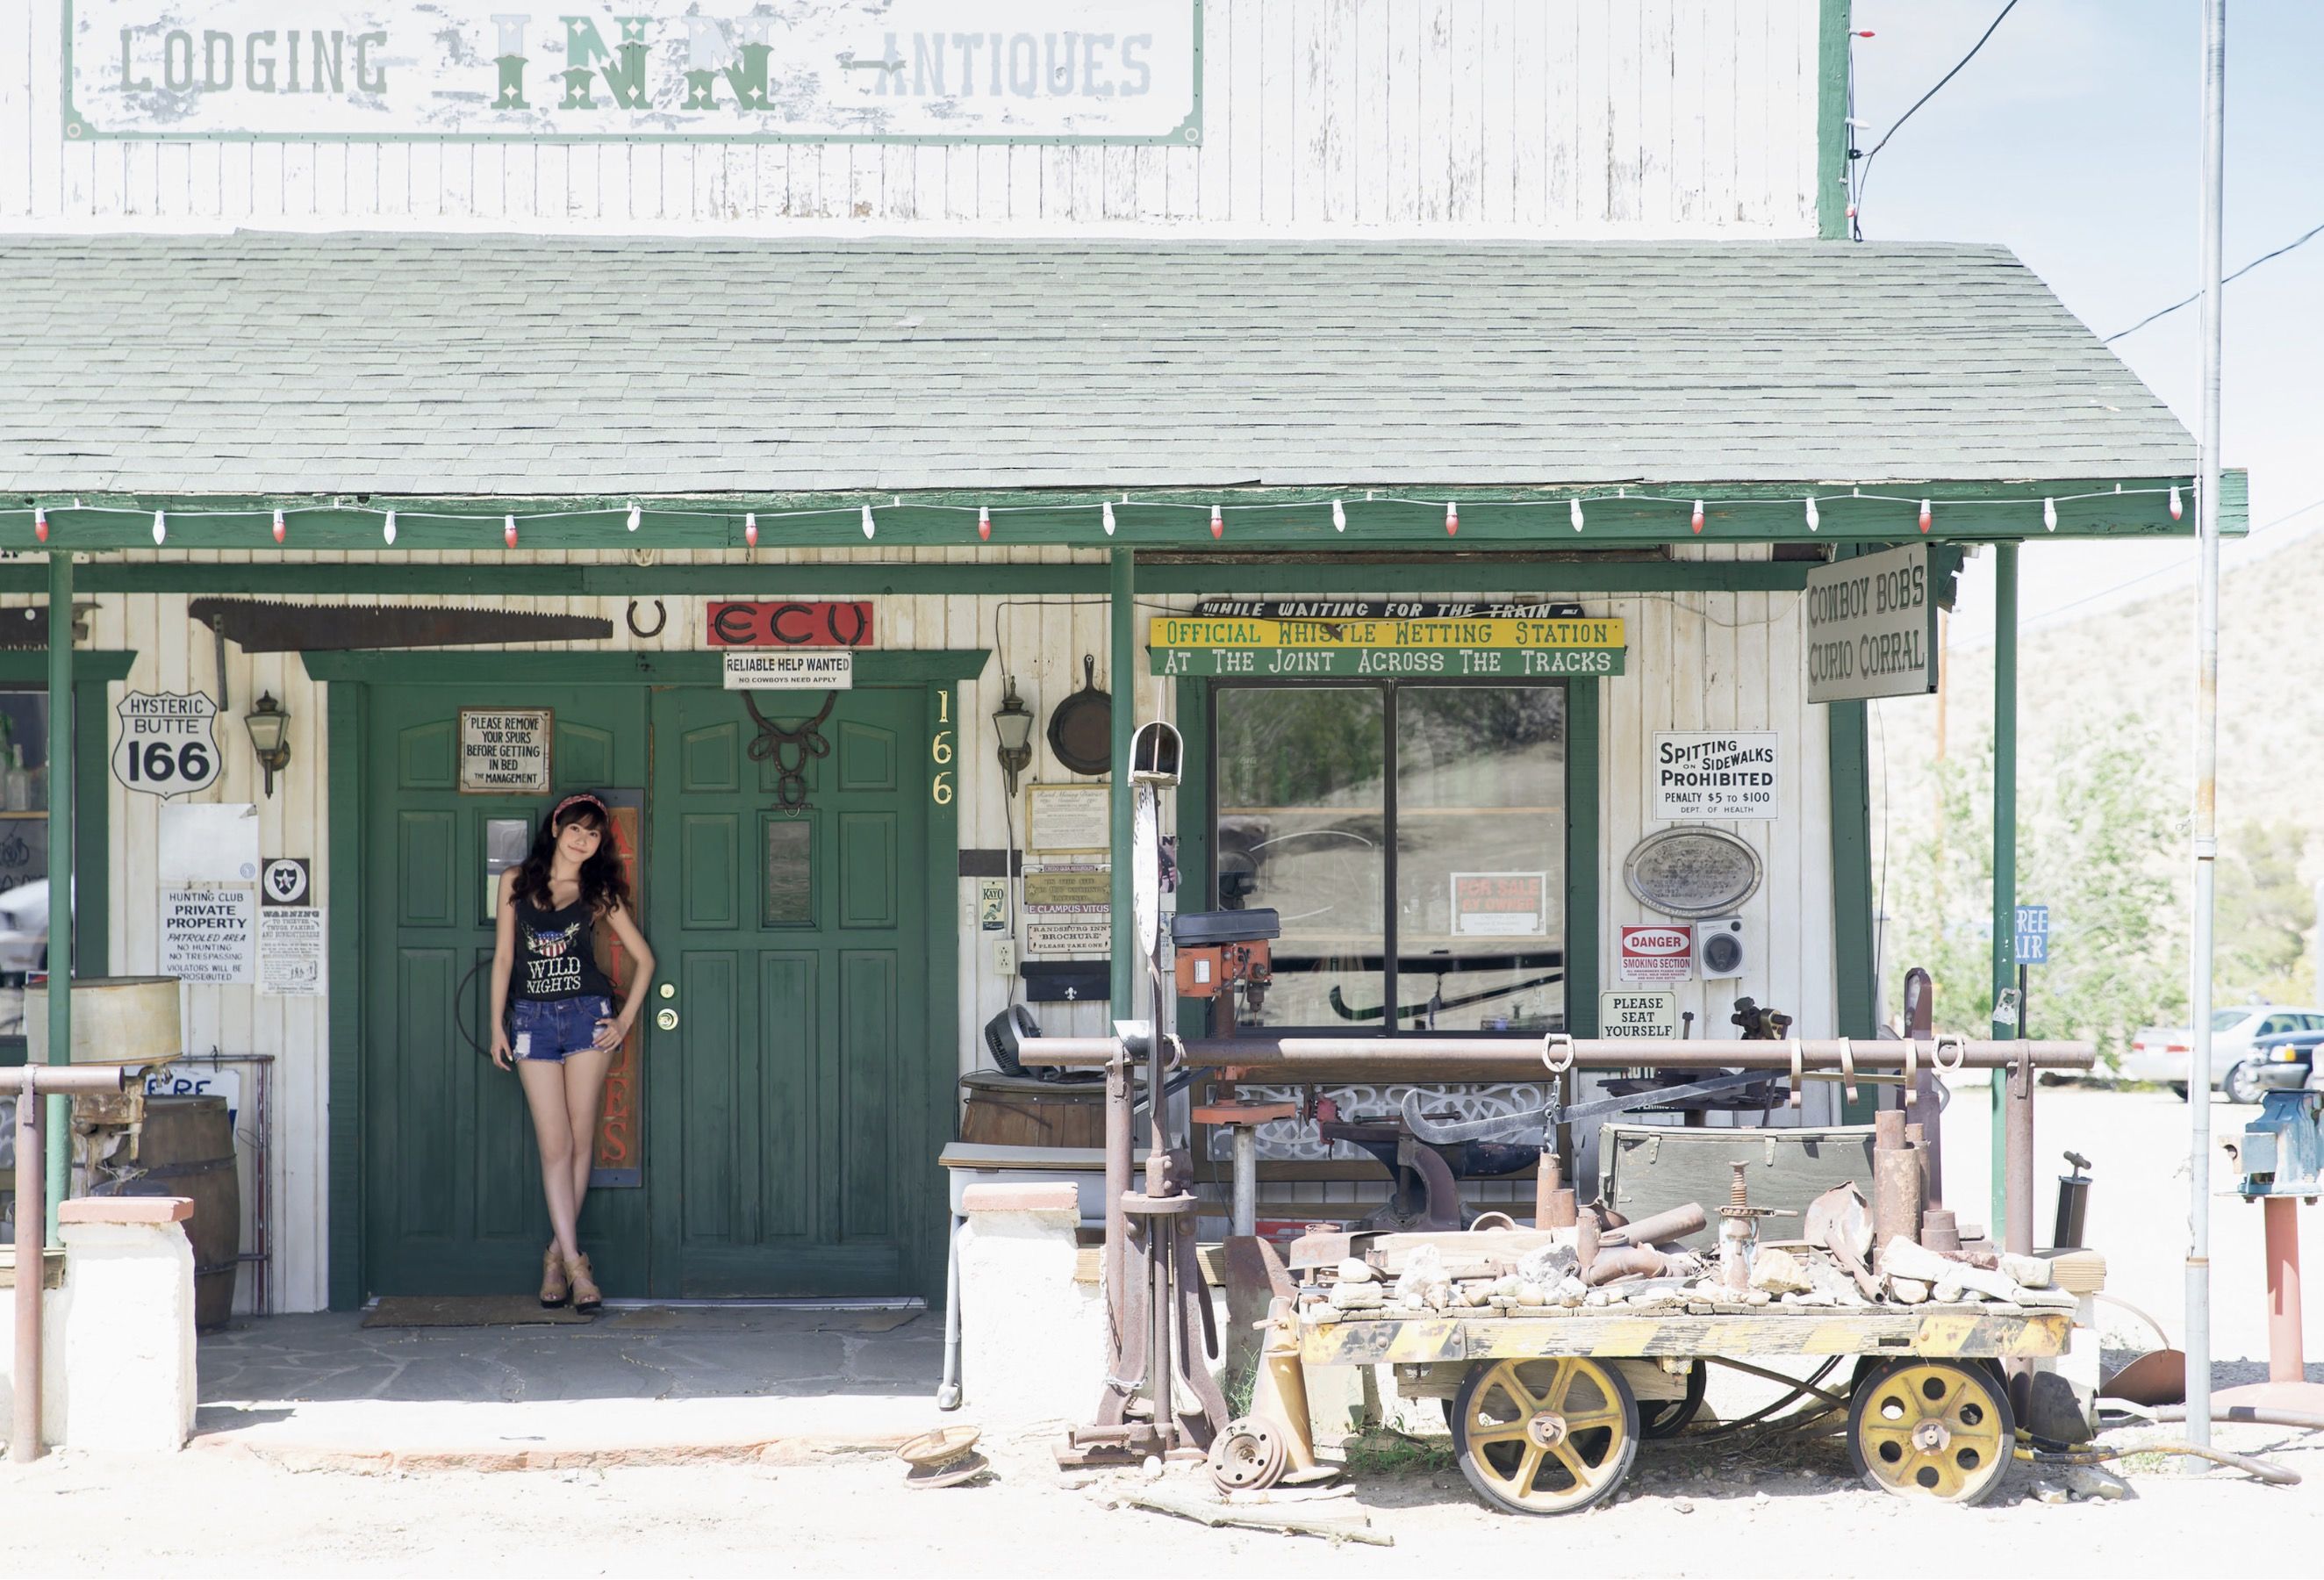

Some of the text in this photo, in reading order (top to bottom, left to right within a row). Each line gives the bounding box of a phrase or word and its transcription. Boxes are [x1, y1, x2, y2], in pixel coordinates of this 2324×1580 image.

[120, 13, 1152, 111] LODGING INN ANTIQUES
[1810, 553, 1925, 627] COWBOY BOB'S
[1201, 603, 1265, 616] WHILE
[1278, 603, 1368, 616] WAITING
[1384, 603, 1424, 616] FOR
[1438, 604, 1476, 616] THE
[1489, 604, 1552, 618] TRAIN
[1167, 621, 1261, 644] OFFICIAL
[1395, 621, 1492, 645] WETTING
[1516, 621, 1608, 645] STATION
[1165, 649, 1611, 674] AT THE JOINT ACROSS THE TRACKS
[1810, 629, 1925, 686] CURIO CORRAL
[727, 658, 849, 672] RELIABLE HELP WANTED
[131, 699, 204, 714] HYSTERIC
[135, 719, 199, 734] BUTTE
[471, 717, 539, 730] PLEASE REMOVE
[482, 731, 531, 743] YOUR SPURS
[467, 744, 540, 758] BEFORE GETTING
[1661, 741, 1737, 764] SPITTING
[128, 741, 210, 781] 166
[489, 759, 518, 771] IN BED
[1702, 748, 1773, 771] SIDEWALKS
[485, 773, 537, 783] MANAGEMENT
[1661, 770, 1773, 786] PROHIBITED
[1665, 793, 1702, 802] PENALTY
[1708, 793, 1722, 803] $5
[1743, 792, 1769, 802] $100
[1458, 878, 1539, 895] FOR SALE
[169, 893, 243, 901] HUNTING CLUB
[983, 888, 1003, 900] KAYO
[176, 906, 236, 915] PRIVATE
[1462, 898, 1534, 911] BY OWNER
[167, 918, 247, 928] PROPERTY
[2016, 909, 2048, 933] REE
[168, 933, 246, 942] PATROLED AREA
[1632, 937, 1681, 947] DANGER
[527, 957, 581, 979] WILD
[1624, 959, 1690, 968] SMOKING SECTION
[527, 976, 581, 994] NIGHTS
[1614, 998, 1663, 1009] PLEASE
[1622, 1012, 1654, 1022] SEAT
[1605, 1026, 1672, 1036] YOURSELF
